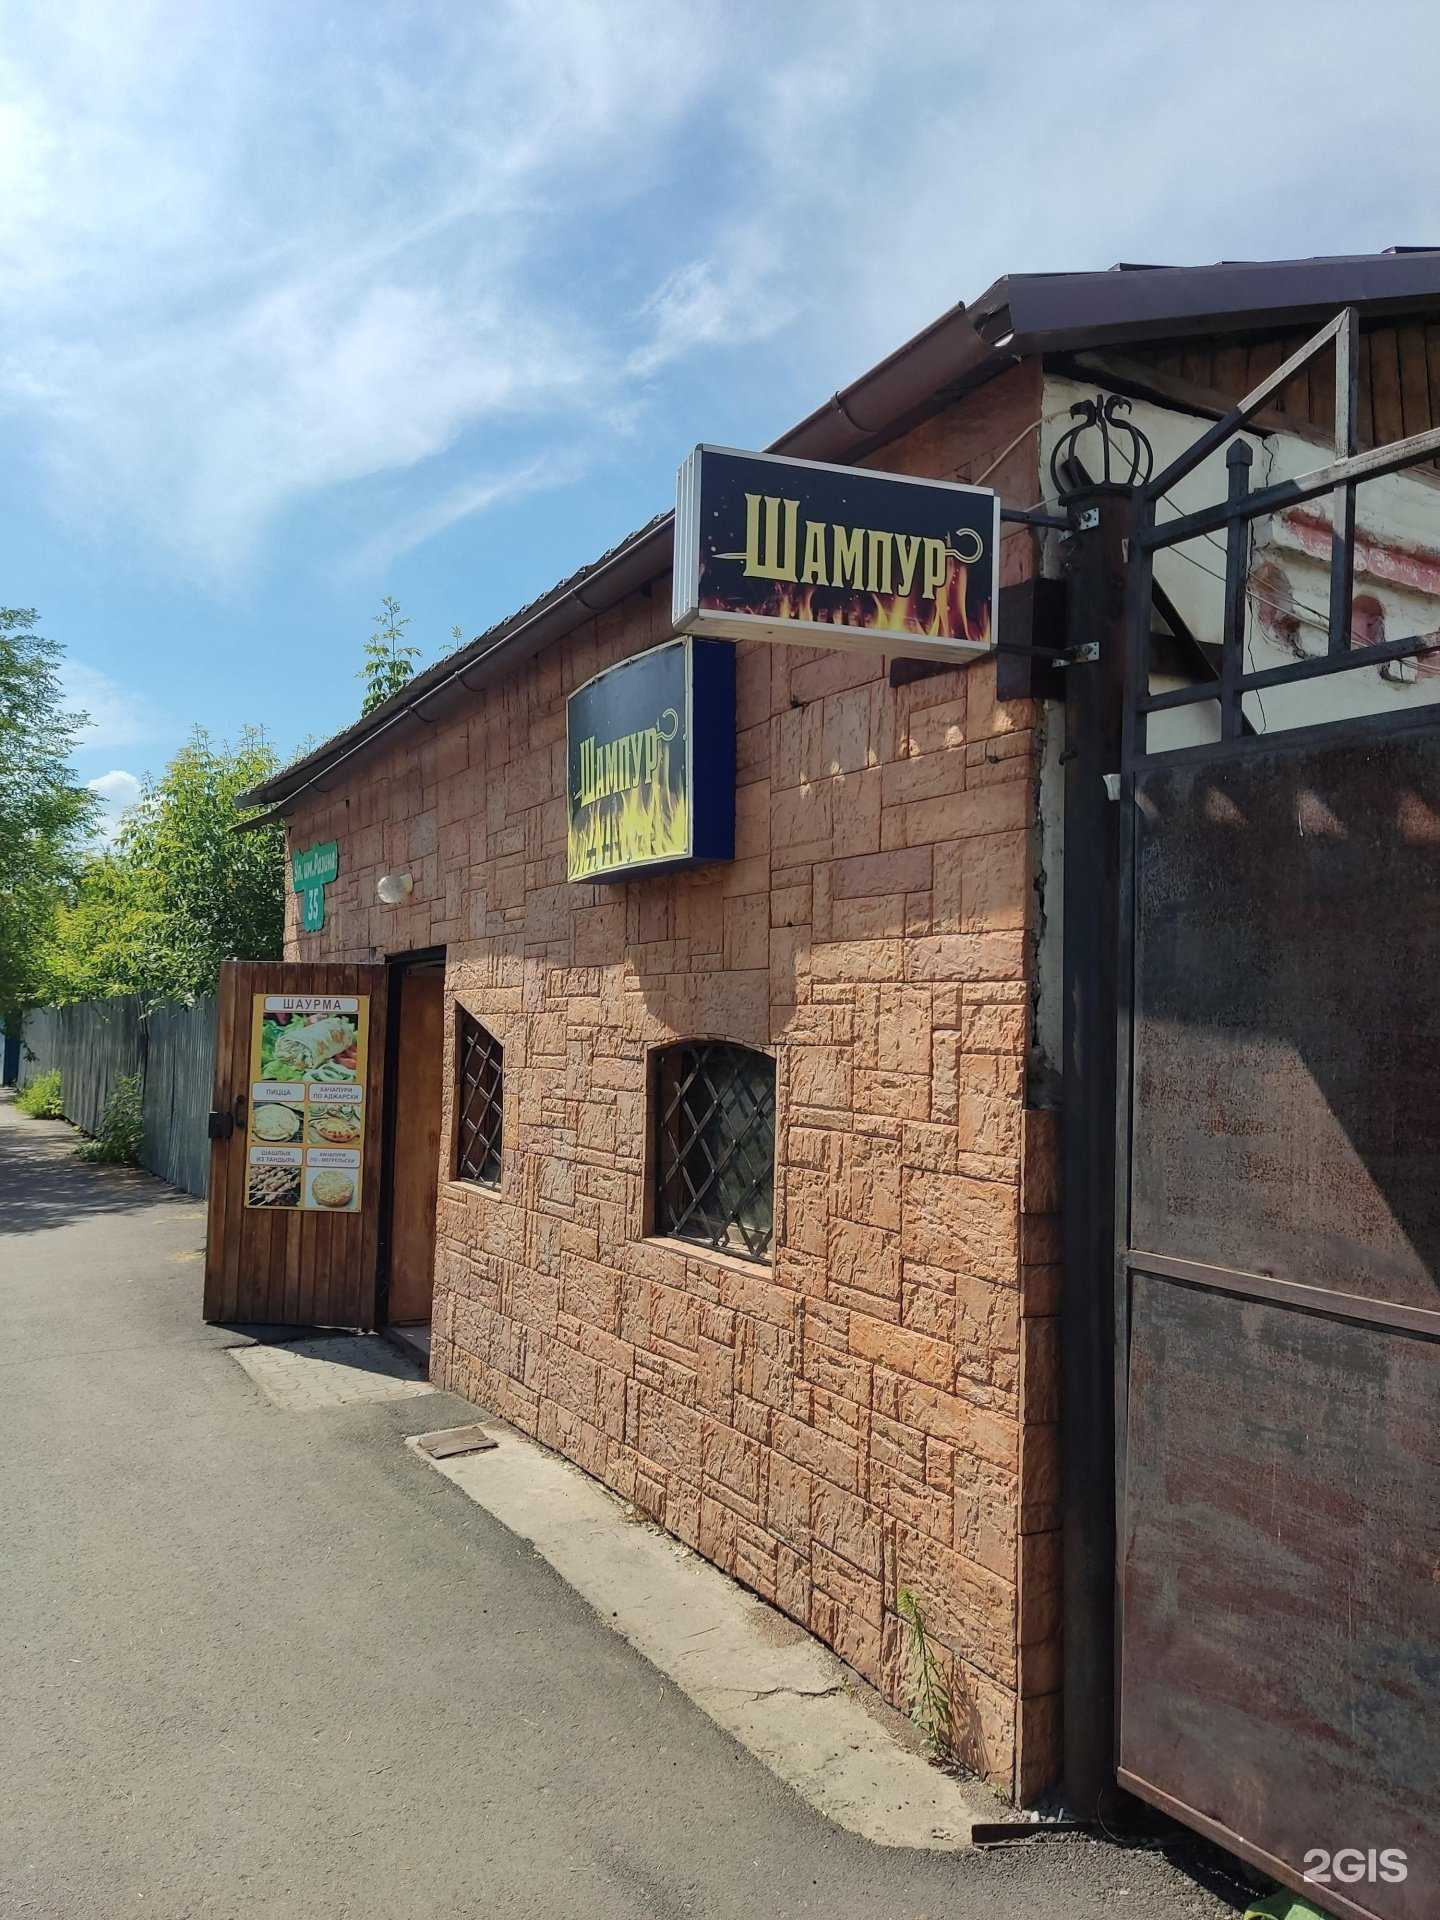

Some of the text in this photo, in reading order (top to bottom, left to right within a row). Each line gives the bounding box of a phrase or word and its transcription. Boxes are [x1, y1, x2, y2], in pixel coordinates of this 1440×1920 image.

[308, 887, 319, 921] 35
[283, 999, 342, 1010] ШАУРМА
[266, 1088, 292, 1097] ПИЦЦА
